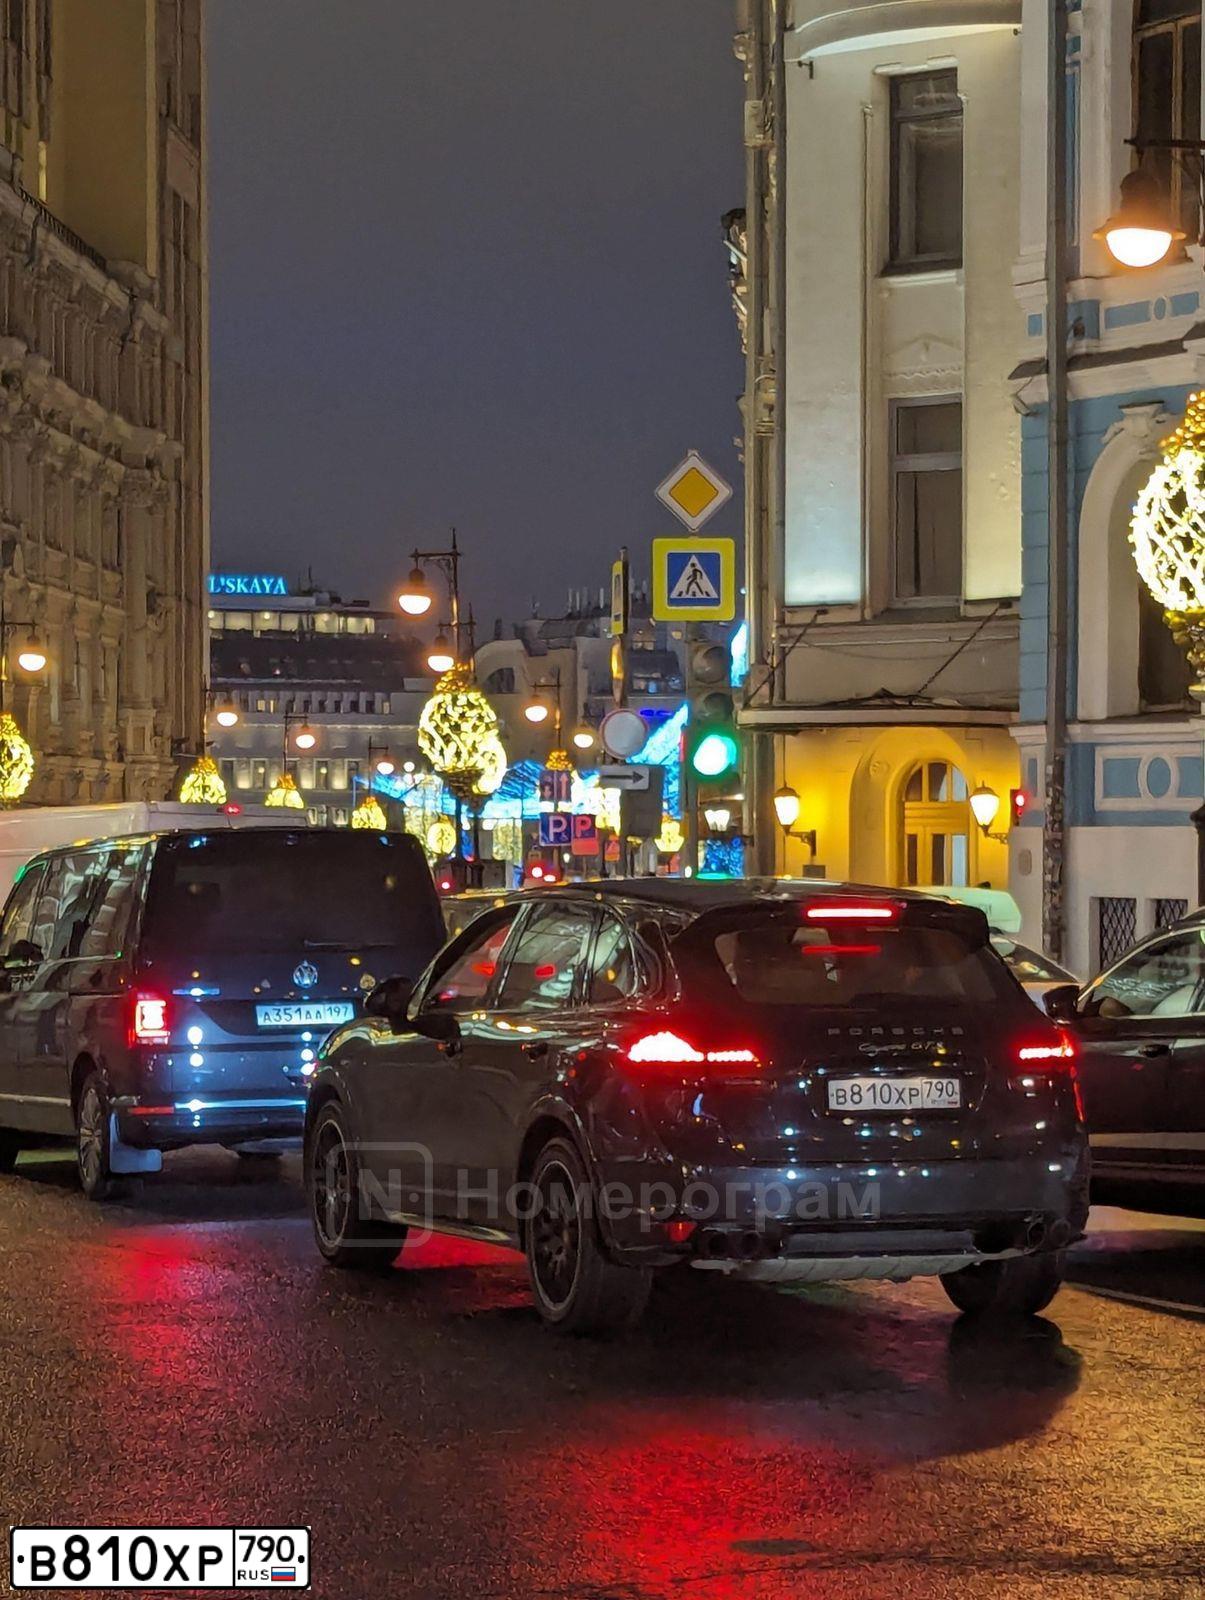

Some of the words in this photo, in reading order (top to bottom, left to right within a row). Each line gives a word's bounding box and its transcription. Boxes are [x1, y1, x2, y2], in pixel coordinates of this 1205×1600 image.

[548, 815, 568, 842] P
[575, 815, 592, 838] P
[835, 1083, 920, 1106] В810ХР
[923, 1080, 955, 1099] 790
